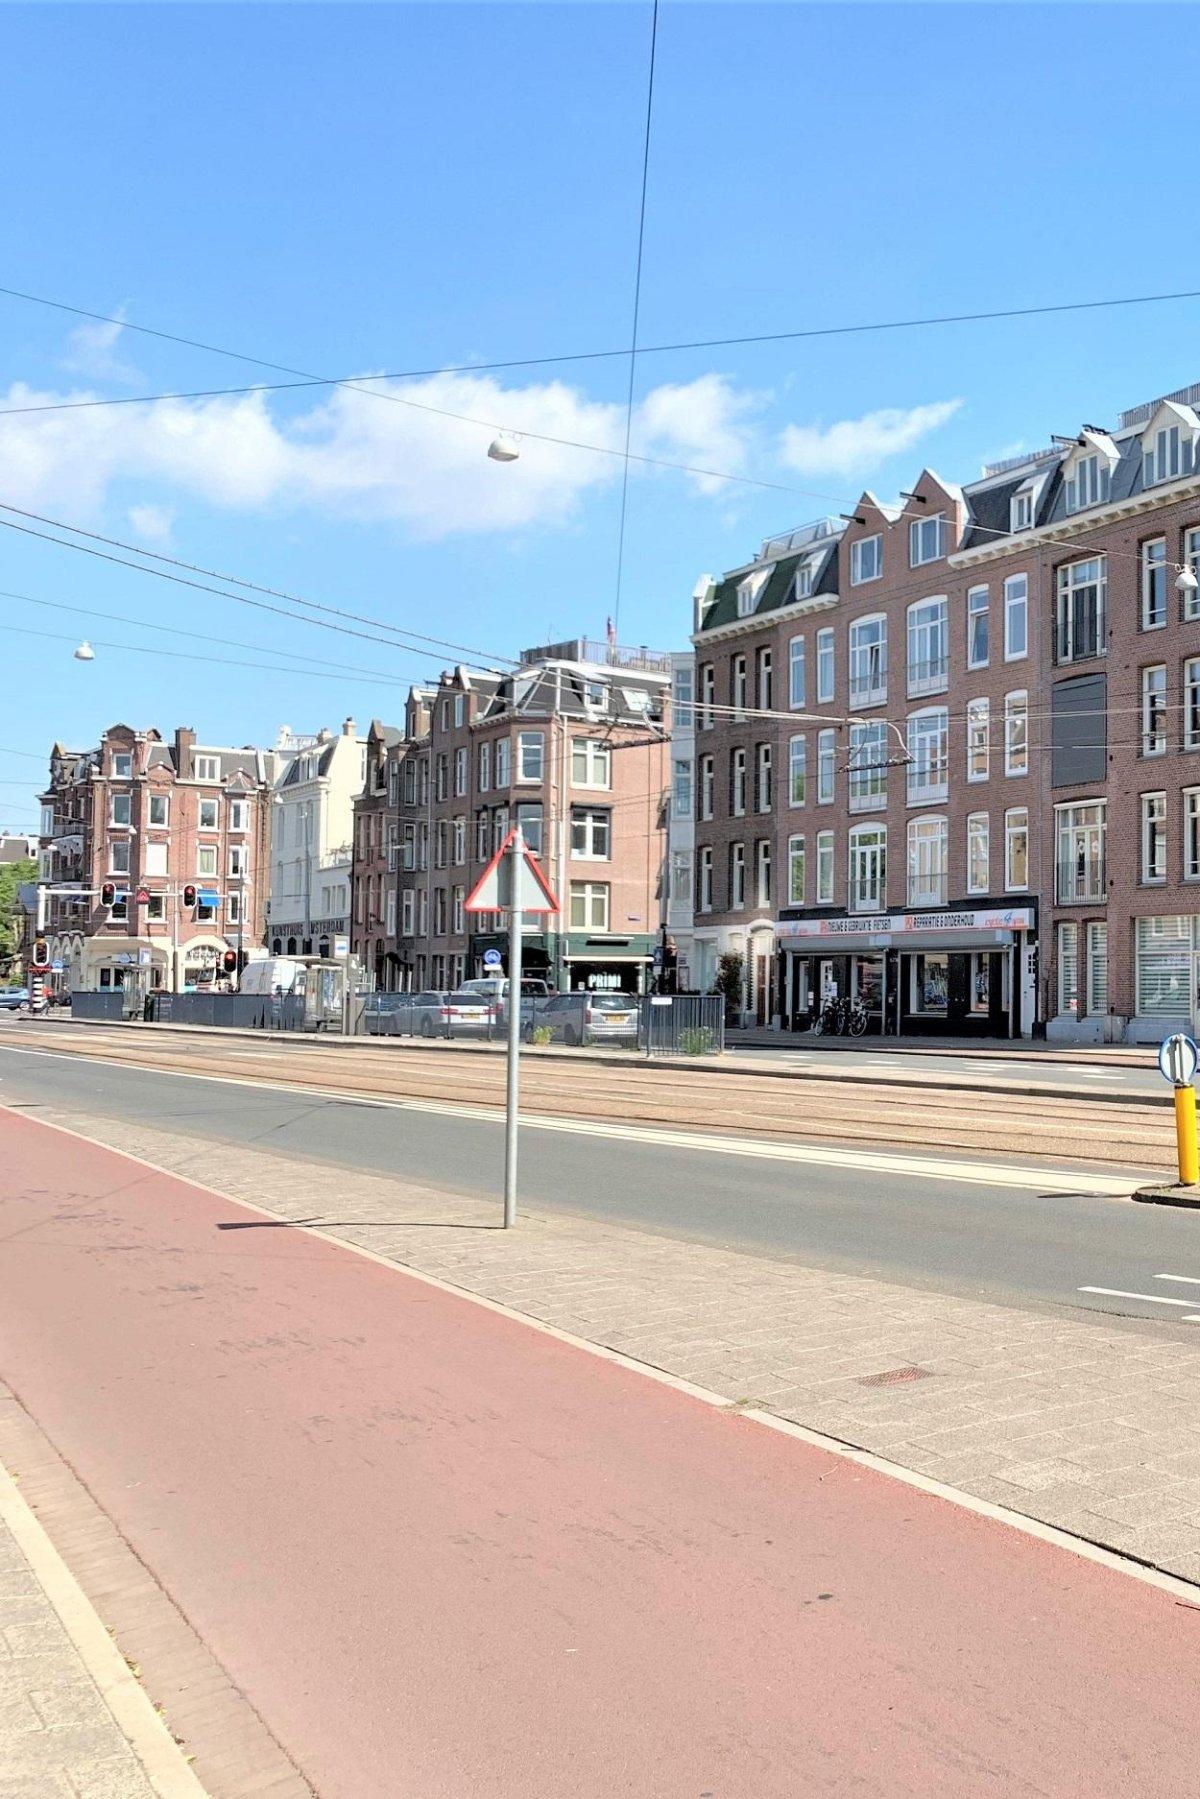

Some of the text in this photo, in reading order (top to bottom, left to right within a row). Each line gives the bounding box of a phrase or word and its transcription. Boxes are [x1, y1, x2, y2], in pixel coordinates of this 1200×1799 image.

[309, 919, 345, 934] MSTERDAM
[913, 915, 940, 928] REPARATIE
[944, 914, 975, 927] ONDERHOUD
